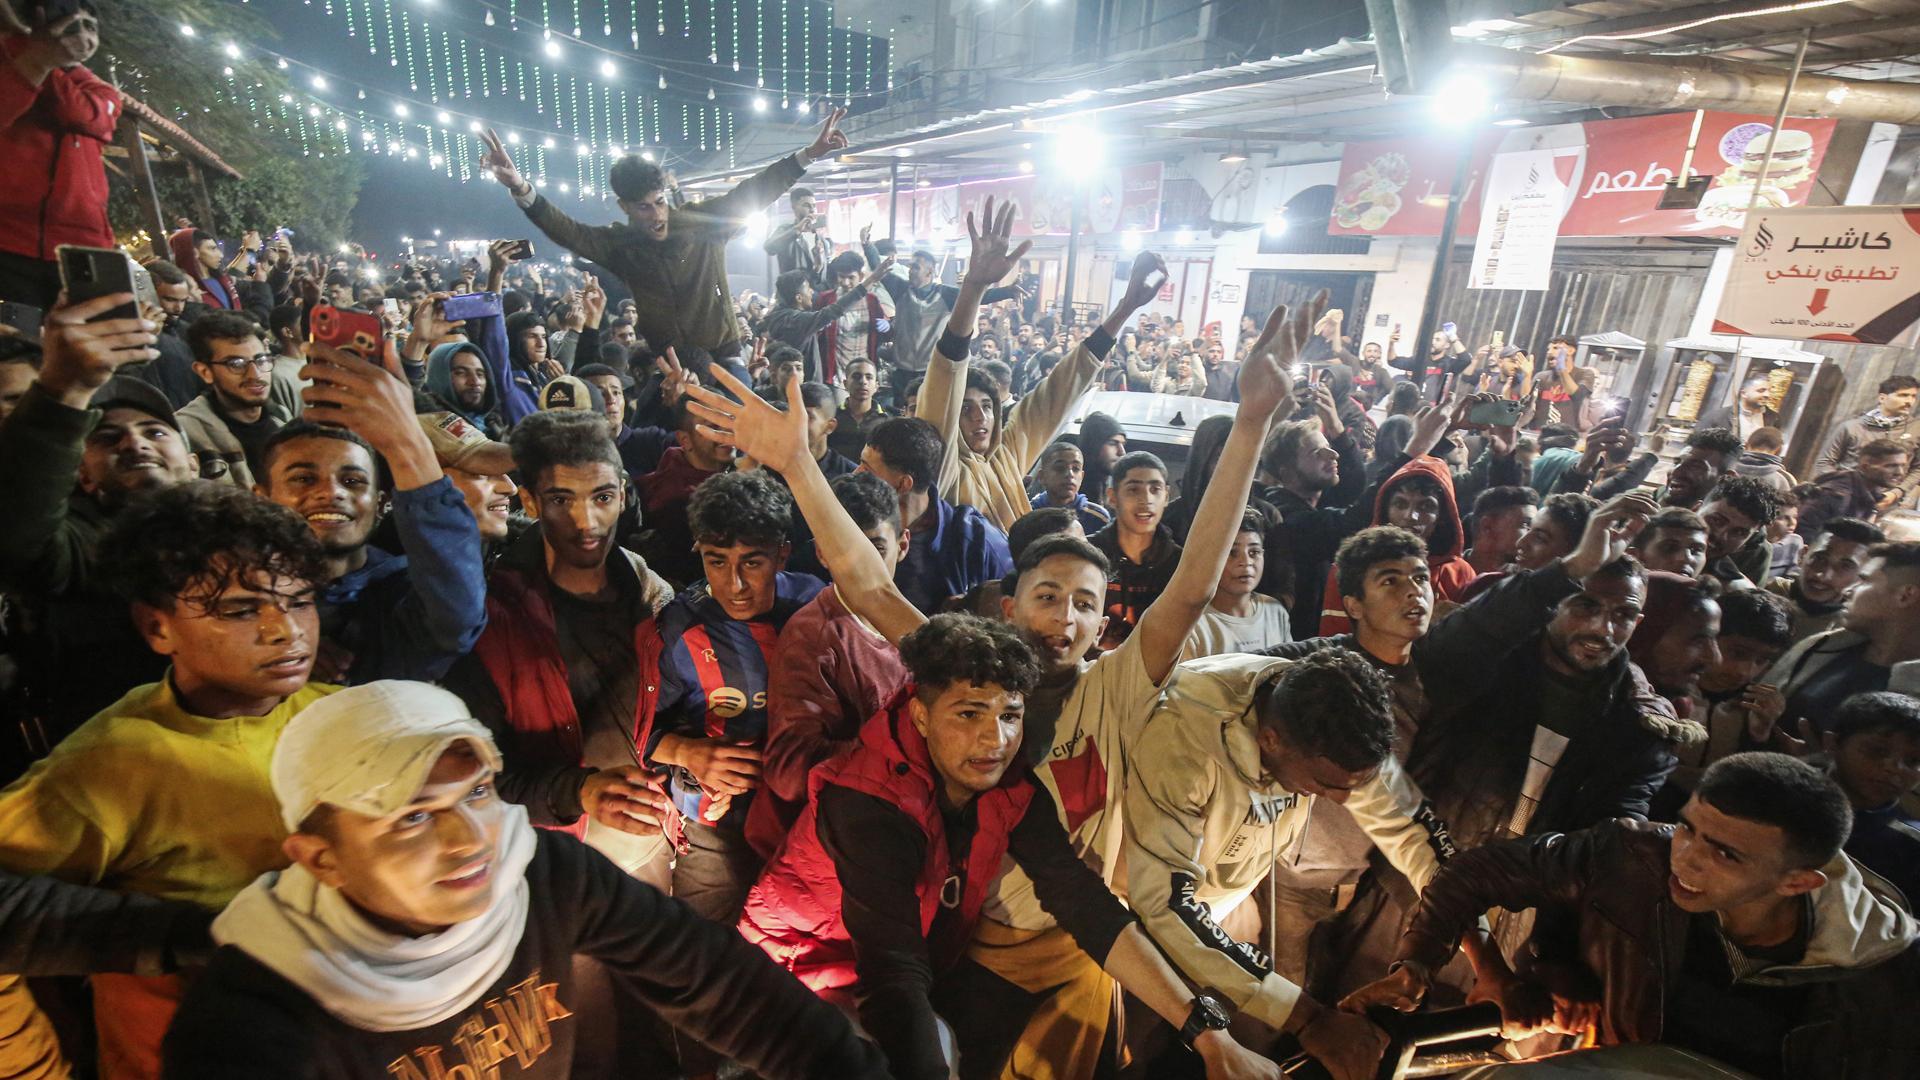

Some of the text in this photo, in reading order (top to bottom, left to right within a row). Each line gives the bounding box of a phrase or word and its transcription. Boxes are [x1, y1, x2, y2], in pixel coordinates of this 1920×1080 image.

[1787, 228, 1892, 253] كاشير
[1765, 264, 1900, 284] تطبيق بنكي
[752, 691, 767, 709] S
[1237, 941, 1270, 970] THE
